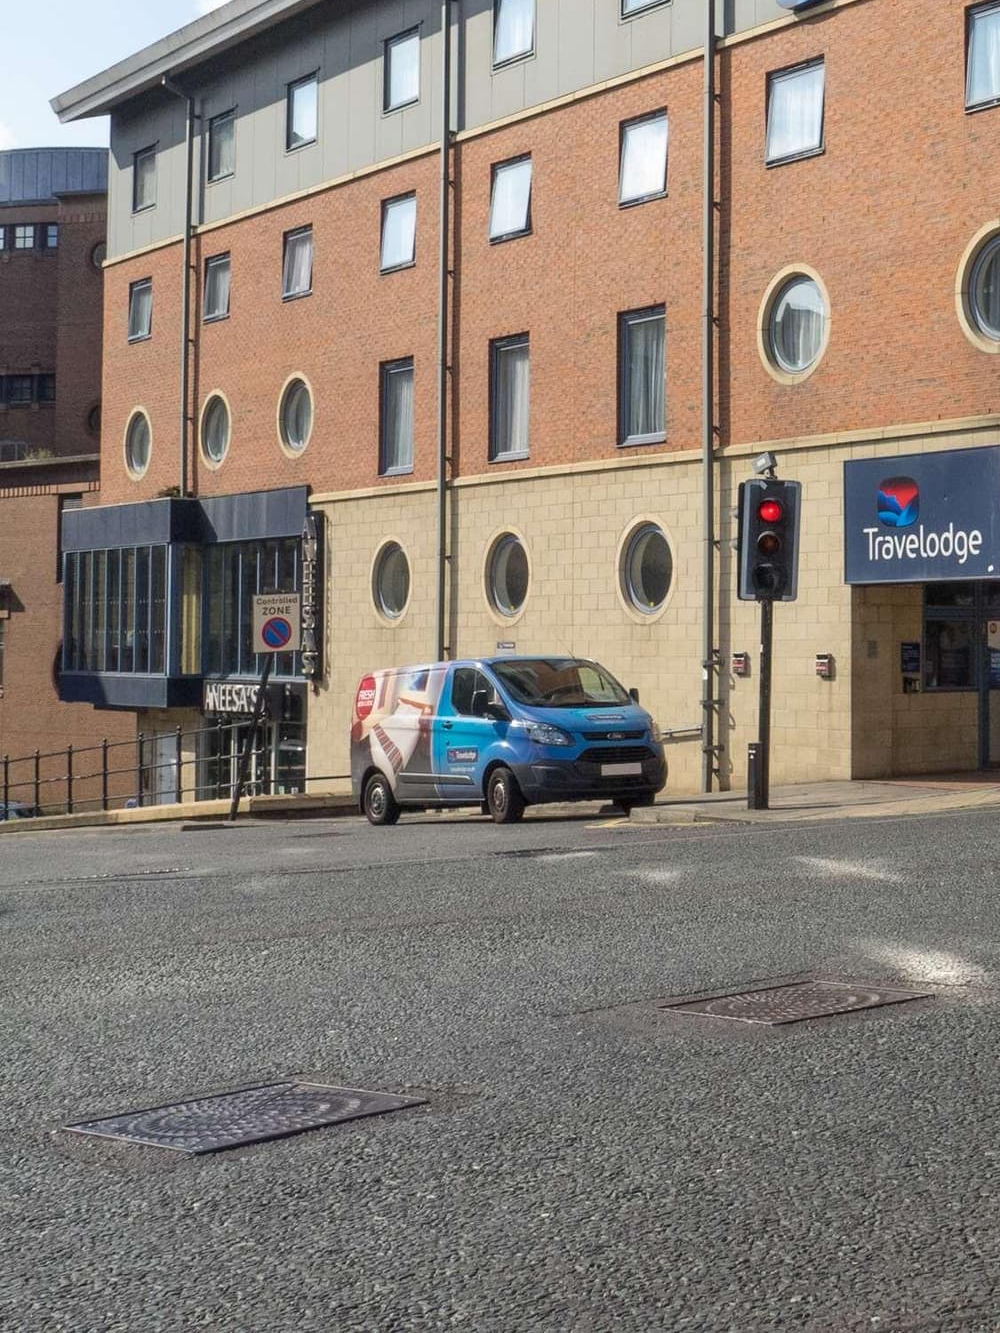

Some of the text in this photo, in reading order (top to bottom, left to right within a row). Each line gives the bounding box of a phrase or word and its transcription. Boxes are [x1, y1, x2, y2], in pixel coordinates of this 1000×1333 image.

[863, 522, 983, 564] Travelodge
[256, 596, 298, 605] Controlled
[262, 606, 291, 616] ZONE
